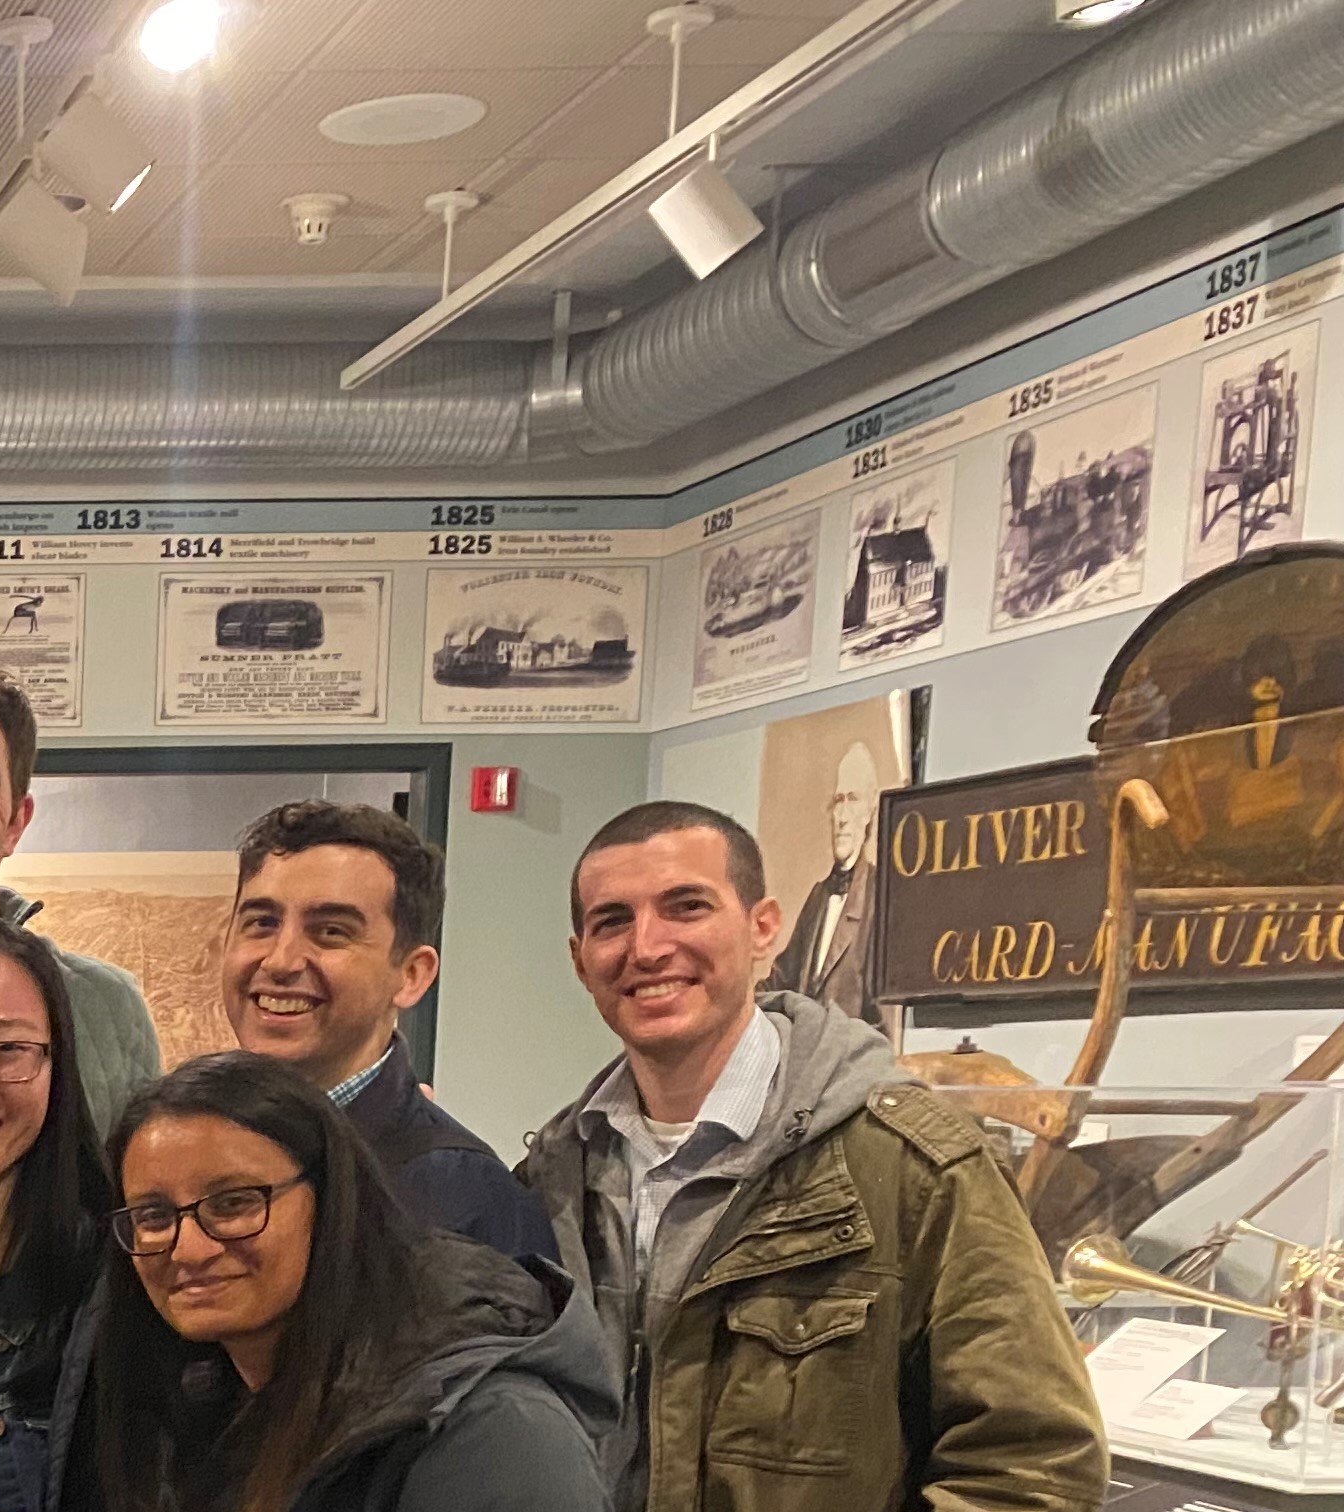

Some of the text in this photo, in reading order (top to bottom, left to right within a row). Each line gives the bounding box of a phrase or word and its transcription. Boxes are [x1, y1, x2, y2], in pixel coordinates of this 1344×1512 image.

[1206, 251, 1261, 300] 1837
[1204, 294, 1259, 341] 1837
[1008, 377, 1054, 418] 1835
[845, 413, 882, 449] 1830
[853, 444, 887, 478] 1831
[77, 509, 141, 530] 1813
[431, 505, 495, 525] 1825
[703, 507, 733, 538] 1828
[160, 537, 223, 558] 1814
[277, 537, 295, 545] and
[428, 534, 492, 555] 1825
[893, 800, 1088, 877] OLIVER
